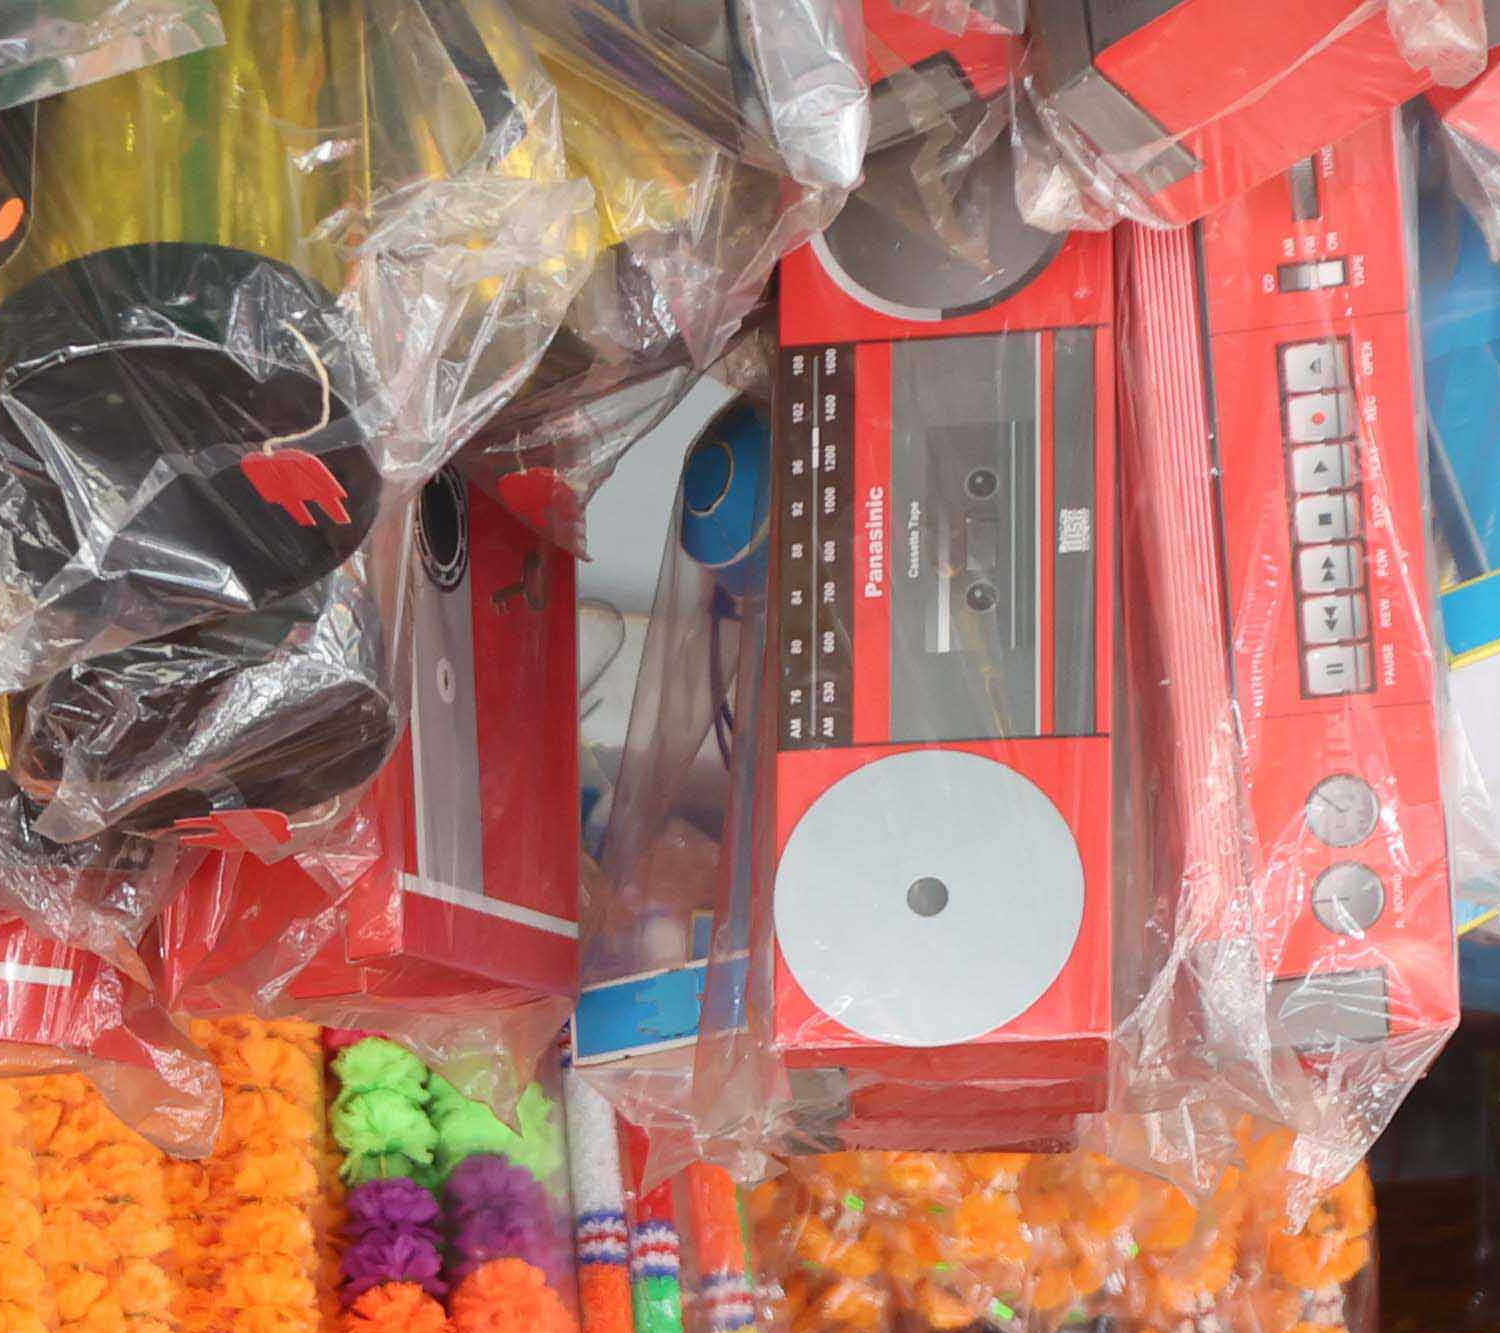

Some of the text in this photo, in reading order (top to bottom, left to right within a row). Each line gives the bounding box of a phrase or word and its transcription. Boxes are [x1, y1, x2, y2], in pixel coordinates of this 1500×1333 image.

[865, 486, 885, 599] Panasinic
[1384, 643, 1396, 685] PAUSE
[791, 718, 804, 738] AM
[823, 717, 836, 737] AM
